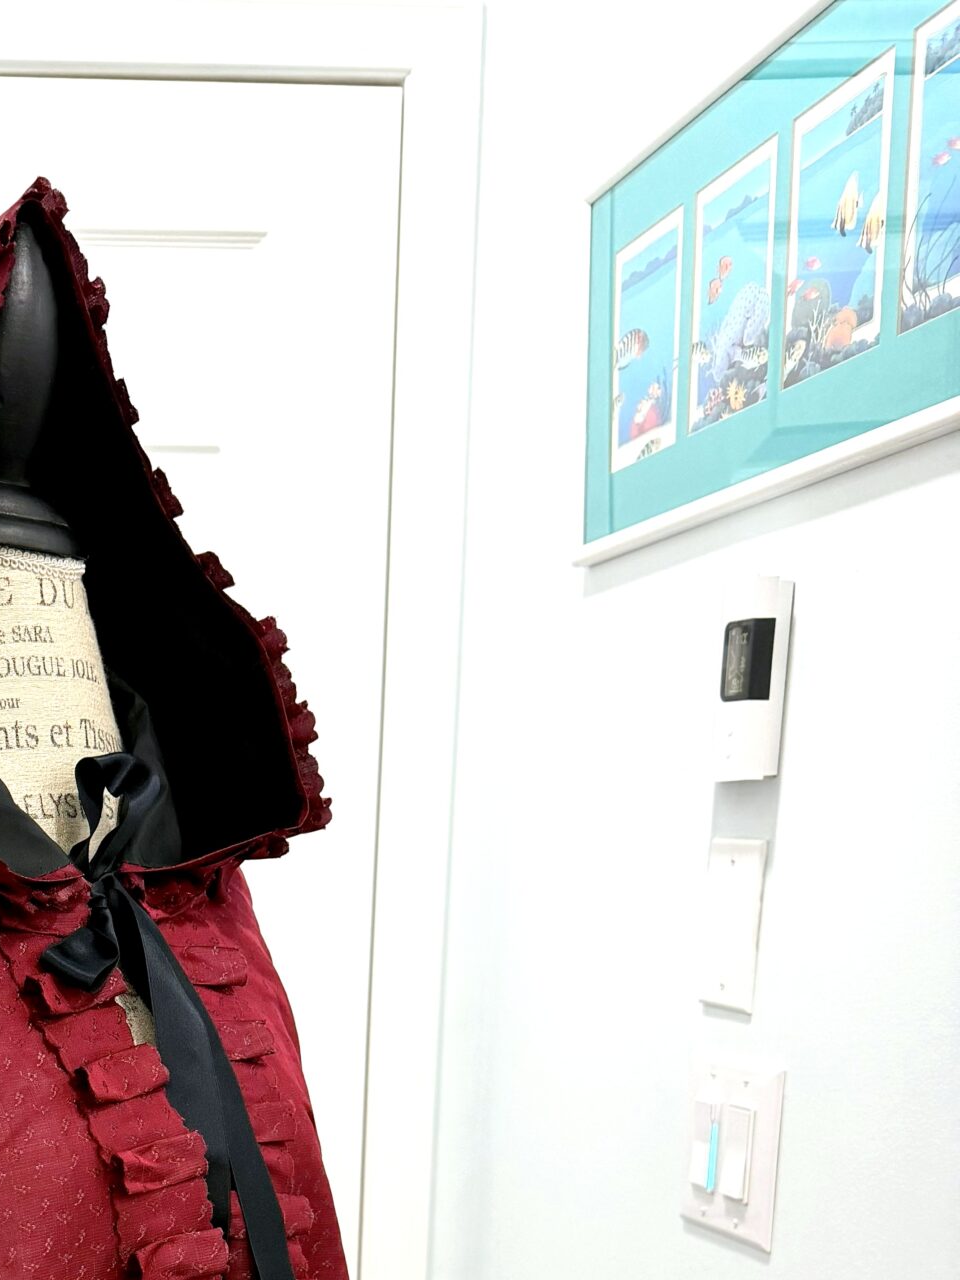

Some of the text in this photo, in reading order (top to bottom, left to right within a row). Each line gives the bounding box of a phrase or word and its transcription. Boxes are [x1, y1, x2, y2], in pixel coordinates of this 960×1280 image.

[35, 577, 75, 609] DU
[11, 624, 54, 644] SARA
[49, 719, 74, 749] et
